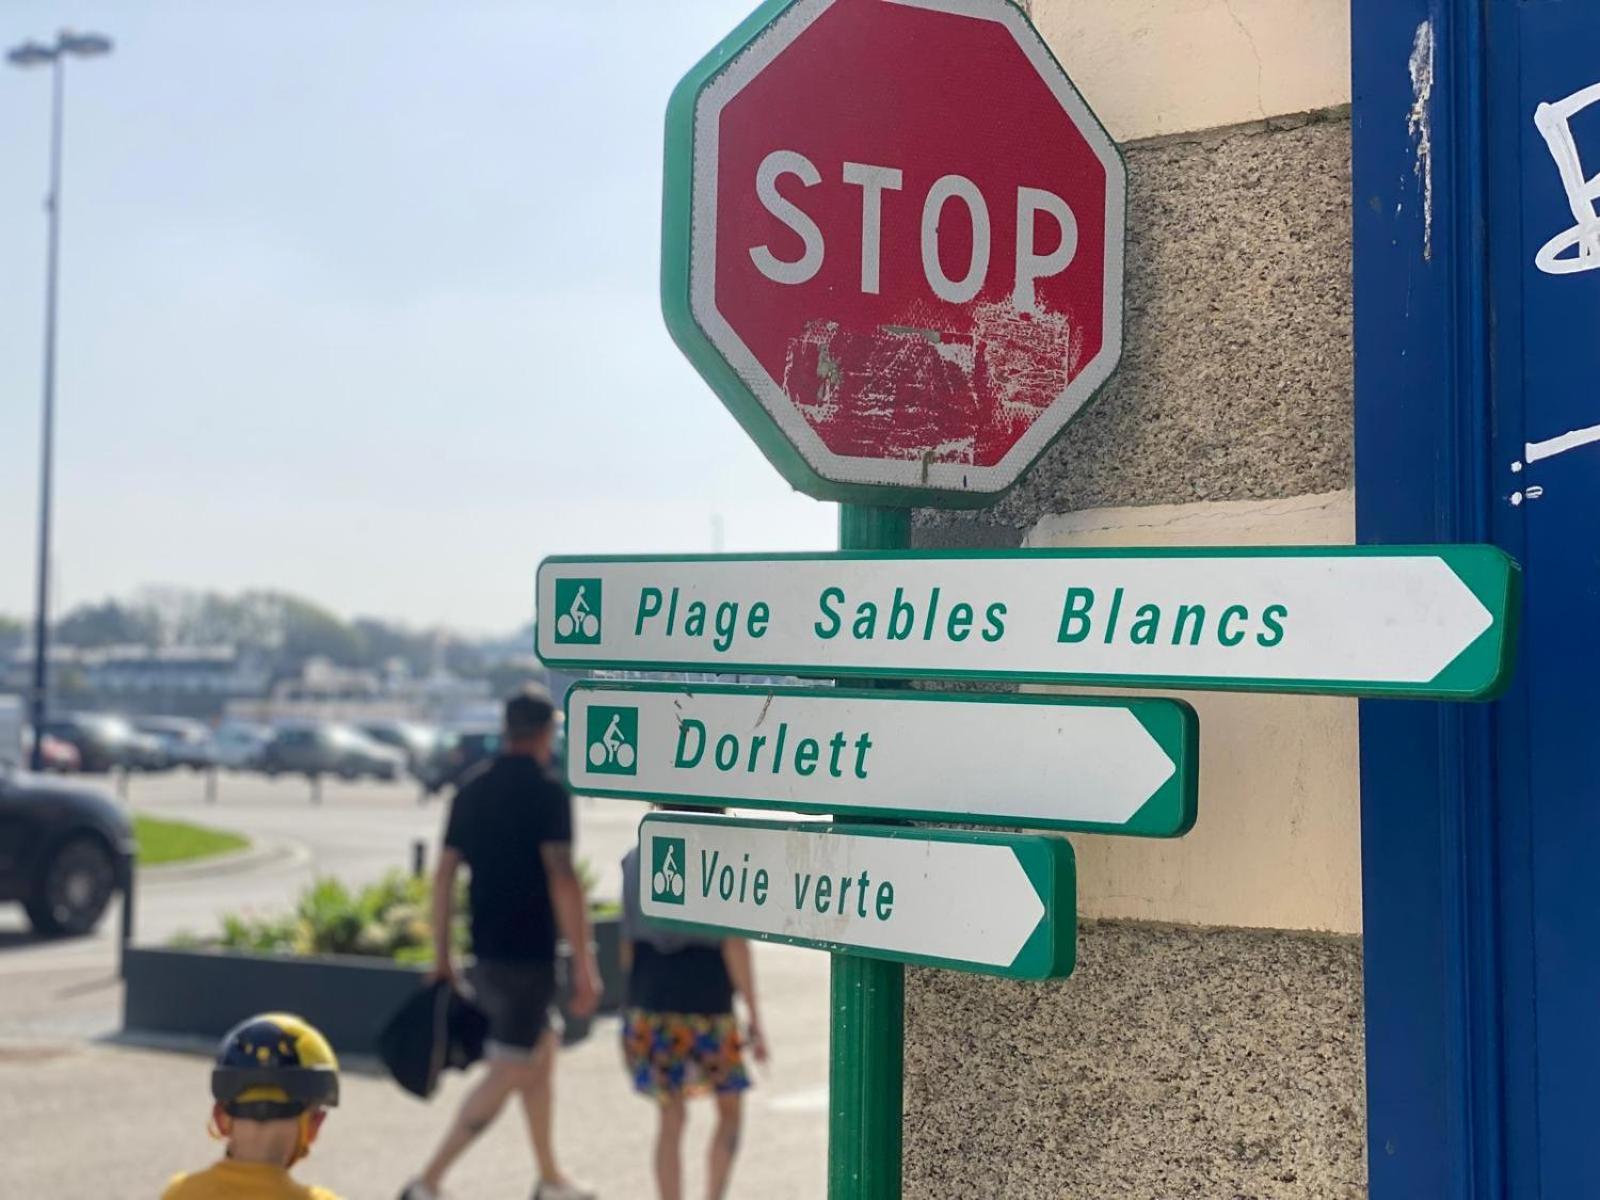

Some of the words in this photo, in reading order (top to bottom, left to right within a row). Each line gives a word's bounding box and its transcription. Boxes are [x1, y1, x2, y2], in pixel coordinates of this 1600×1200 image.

[749, 150, 1079, 314] STOP
[635, 587, 771, 652] Plage
[814, 587, 1008, 643] Sables
[1057, 587, 1290, 648] Blancs
[674, 719, 874, 780] Dorlett
[700, 849, 770, 906] Voie
[794, 869, 896, 922] verte
